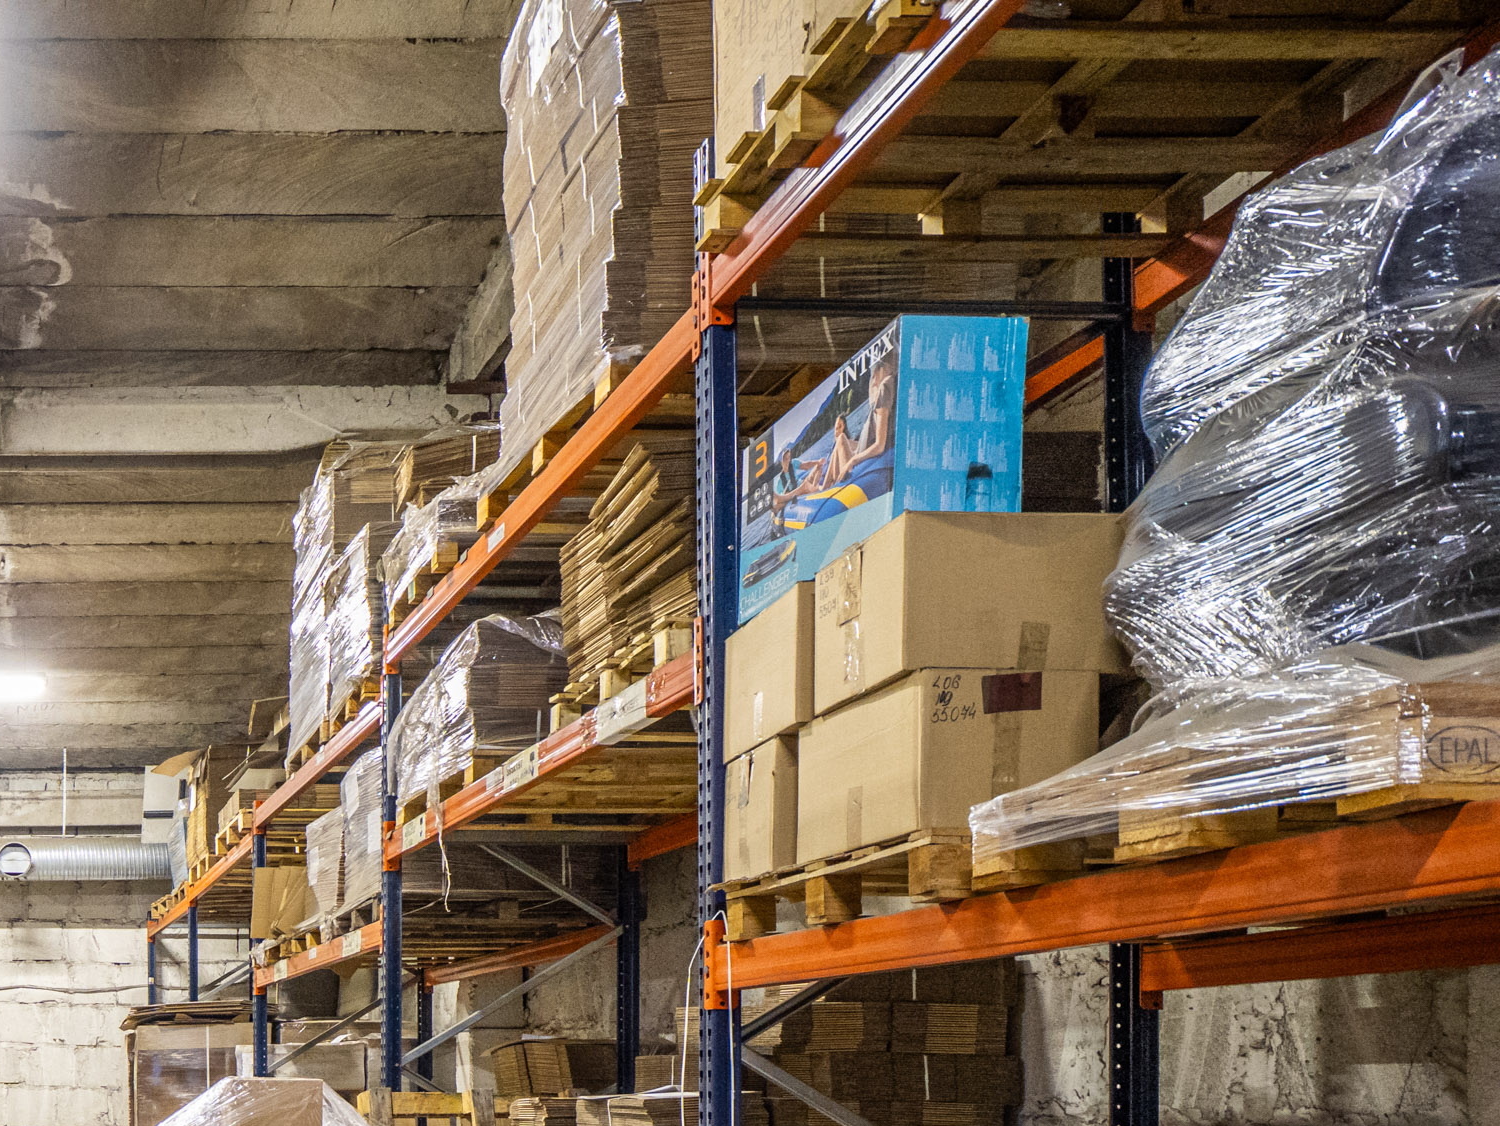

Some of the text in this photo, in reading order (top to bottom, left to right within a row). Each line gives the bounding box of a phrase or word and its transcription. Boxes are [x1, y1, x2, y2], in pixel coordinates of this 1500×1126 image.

[837, 325, 897, 395] INTEX
[755, 440, 768, 479] 3
[739, 567, 791, 611] CHALLENGER
[792, 562, 799, 577] 3
[1439, 736, 1498, 764] EPAL
